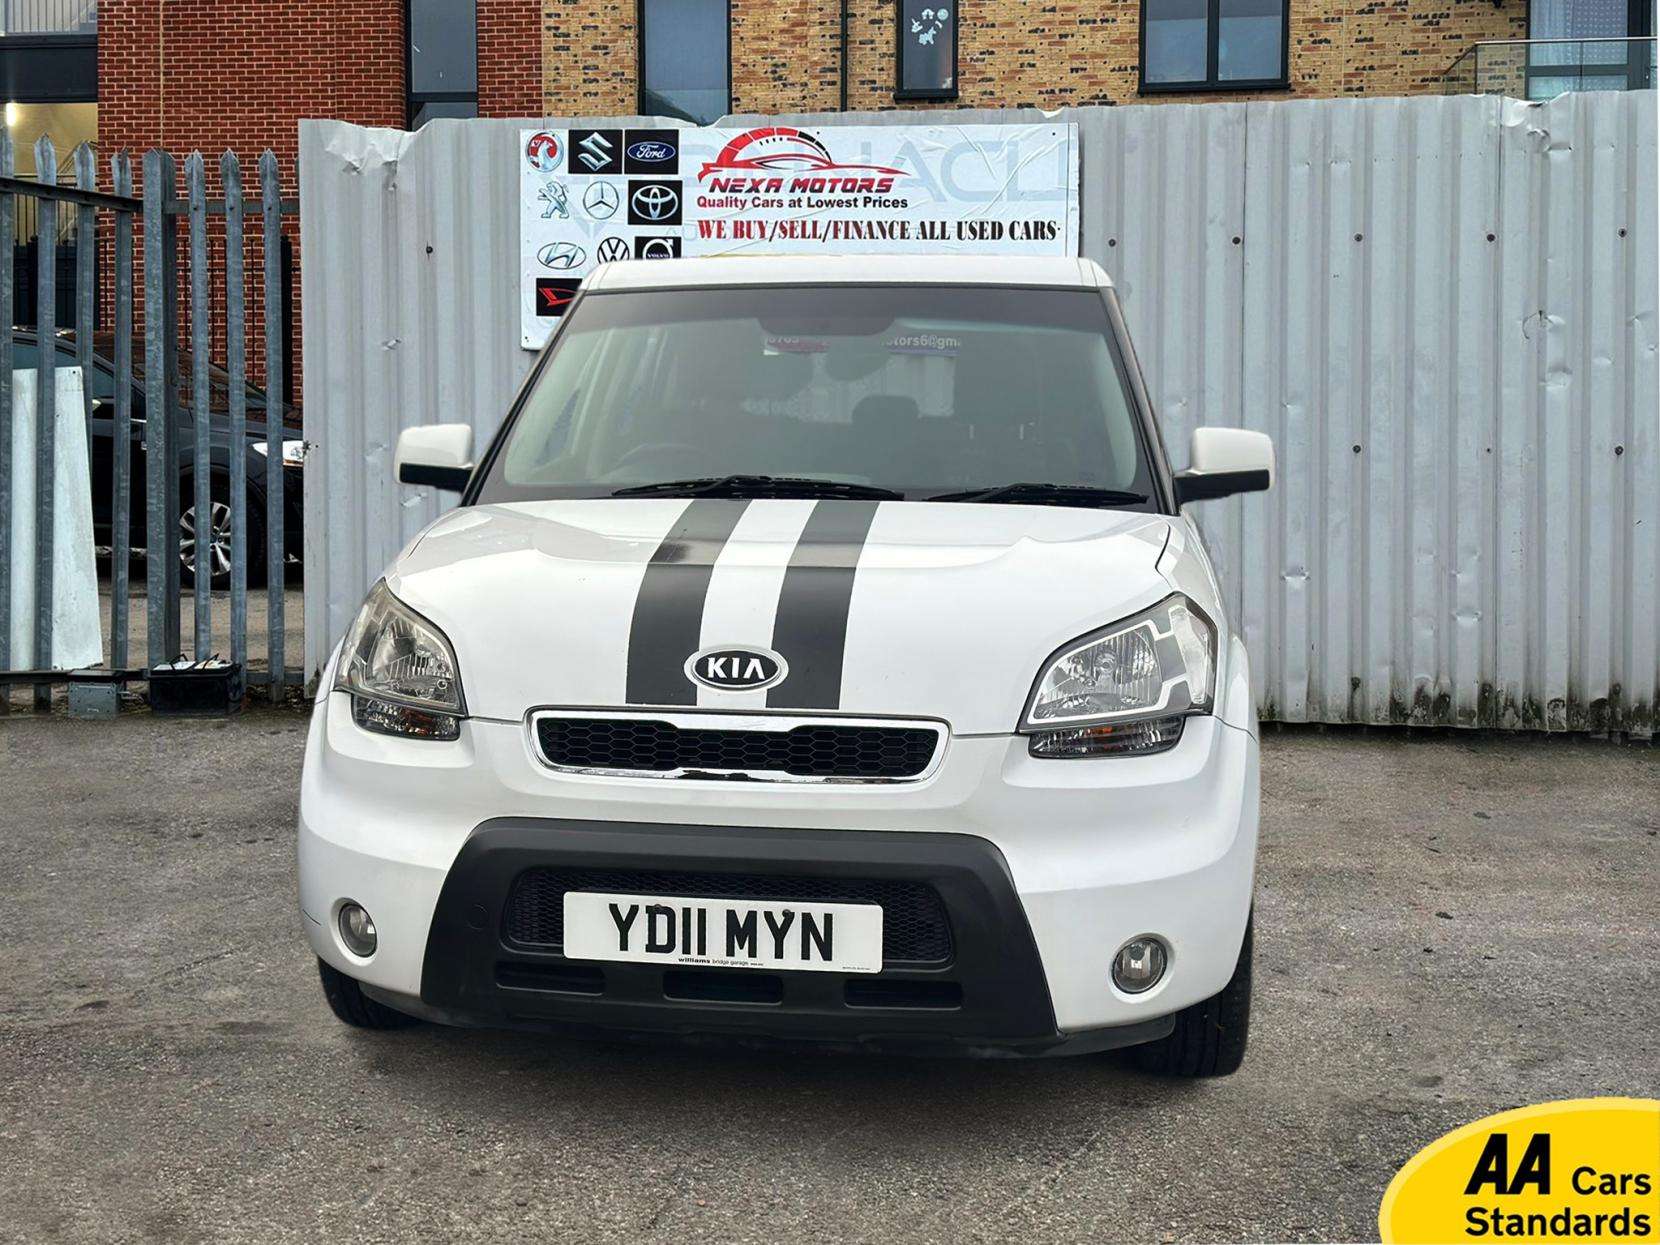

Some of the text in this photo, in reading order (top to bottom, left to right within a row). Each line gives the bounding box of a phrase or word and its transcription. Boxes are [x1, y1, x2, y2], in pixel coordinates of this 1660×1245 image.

[636, 144, 666, 159] Ford
[708, 177, 895, 193] NEXA MOTORS
[697, 196, 908, 210] Quality Cars at Lowest Prices
[697, 220, 727, 240] WE
[916, 220, 951, 240] ALL
[956, 220, 1004, 241] USED
[1008, 220, 1057, 241] CARS
[707, 657, 766, 680] KIA
[608, 903, 833, 961] YD11 MYN
